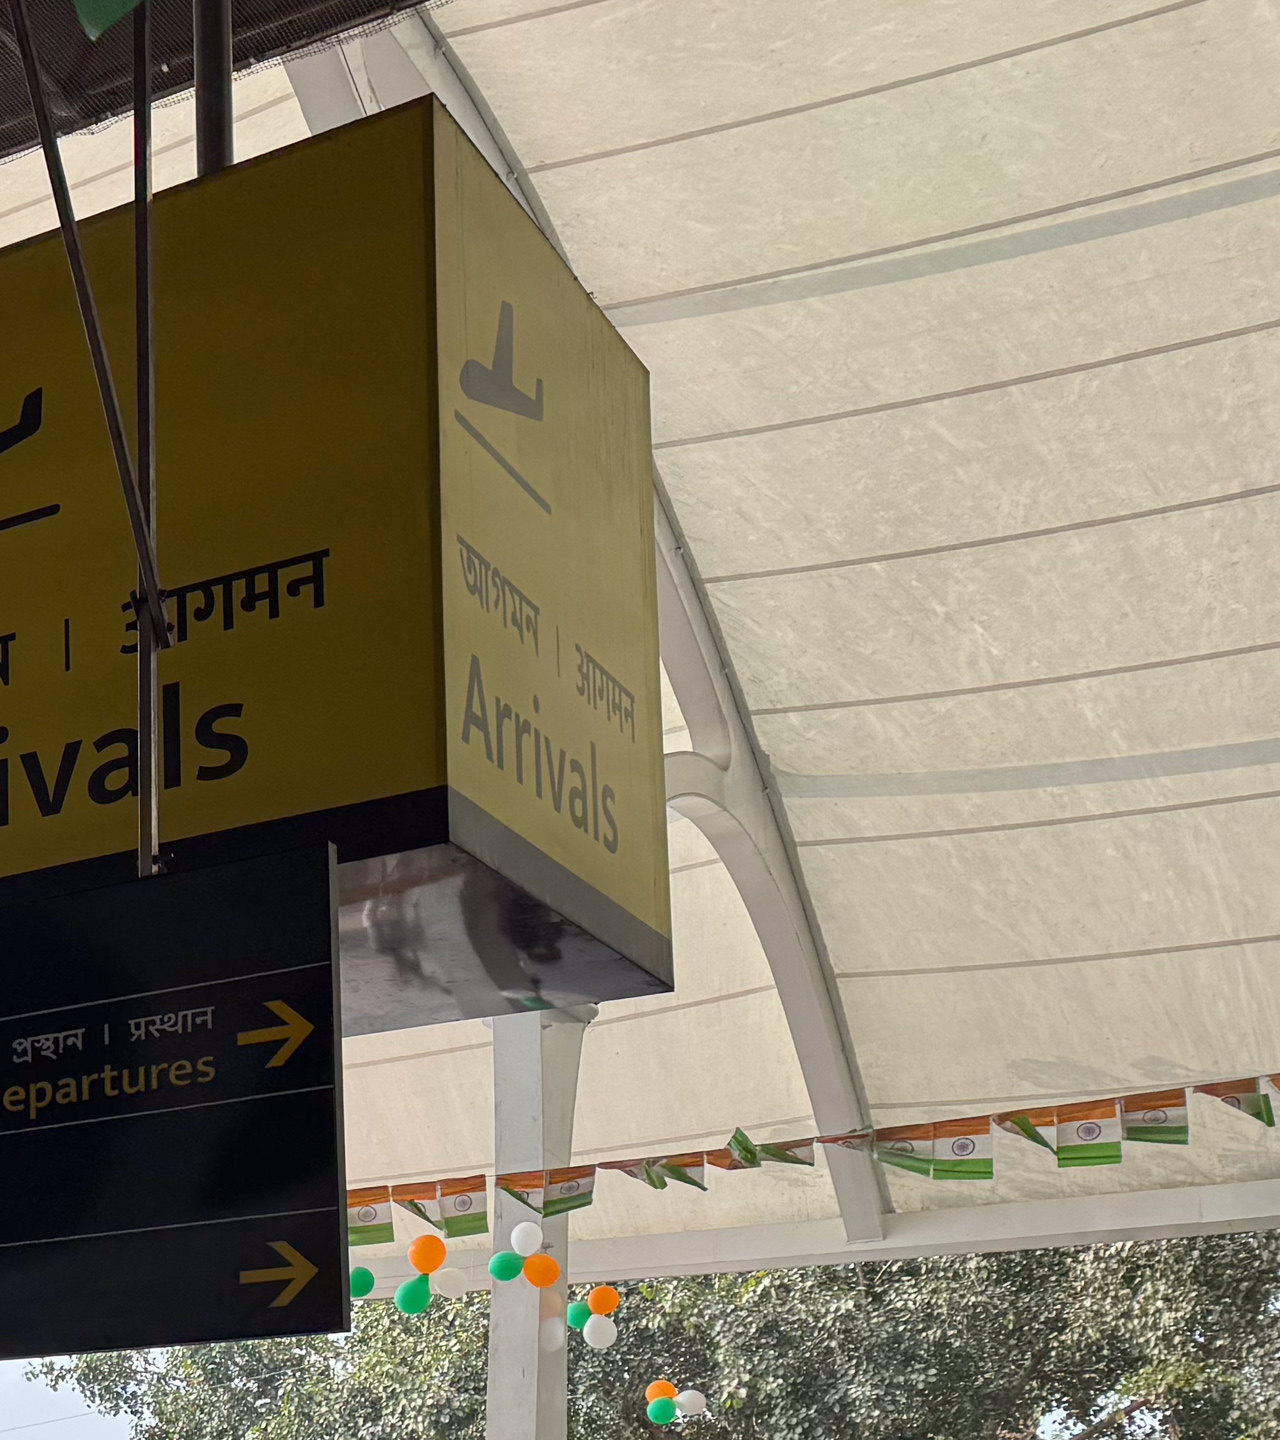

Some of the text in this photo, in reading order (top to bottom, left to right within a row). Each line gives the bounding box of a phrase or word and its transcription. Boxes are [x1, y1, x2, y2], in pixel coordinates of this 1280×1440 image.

[457, 534, 540, 657] আগমন
[575, 643, 635, 743] आगमन
[462, 654, 618, 854] Arrivals
[12, 1027, 86, 1063] প্রস্থান
[128, 1006, 215, 1042] प्रस्थान
